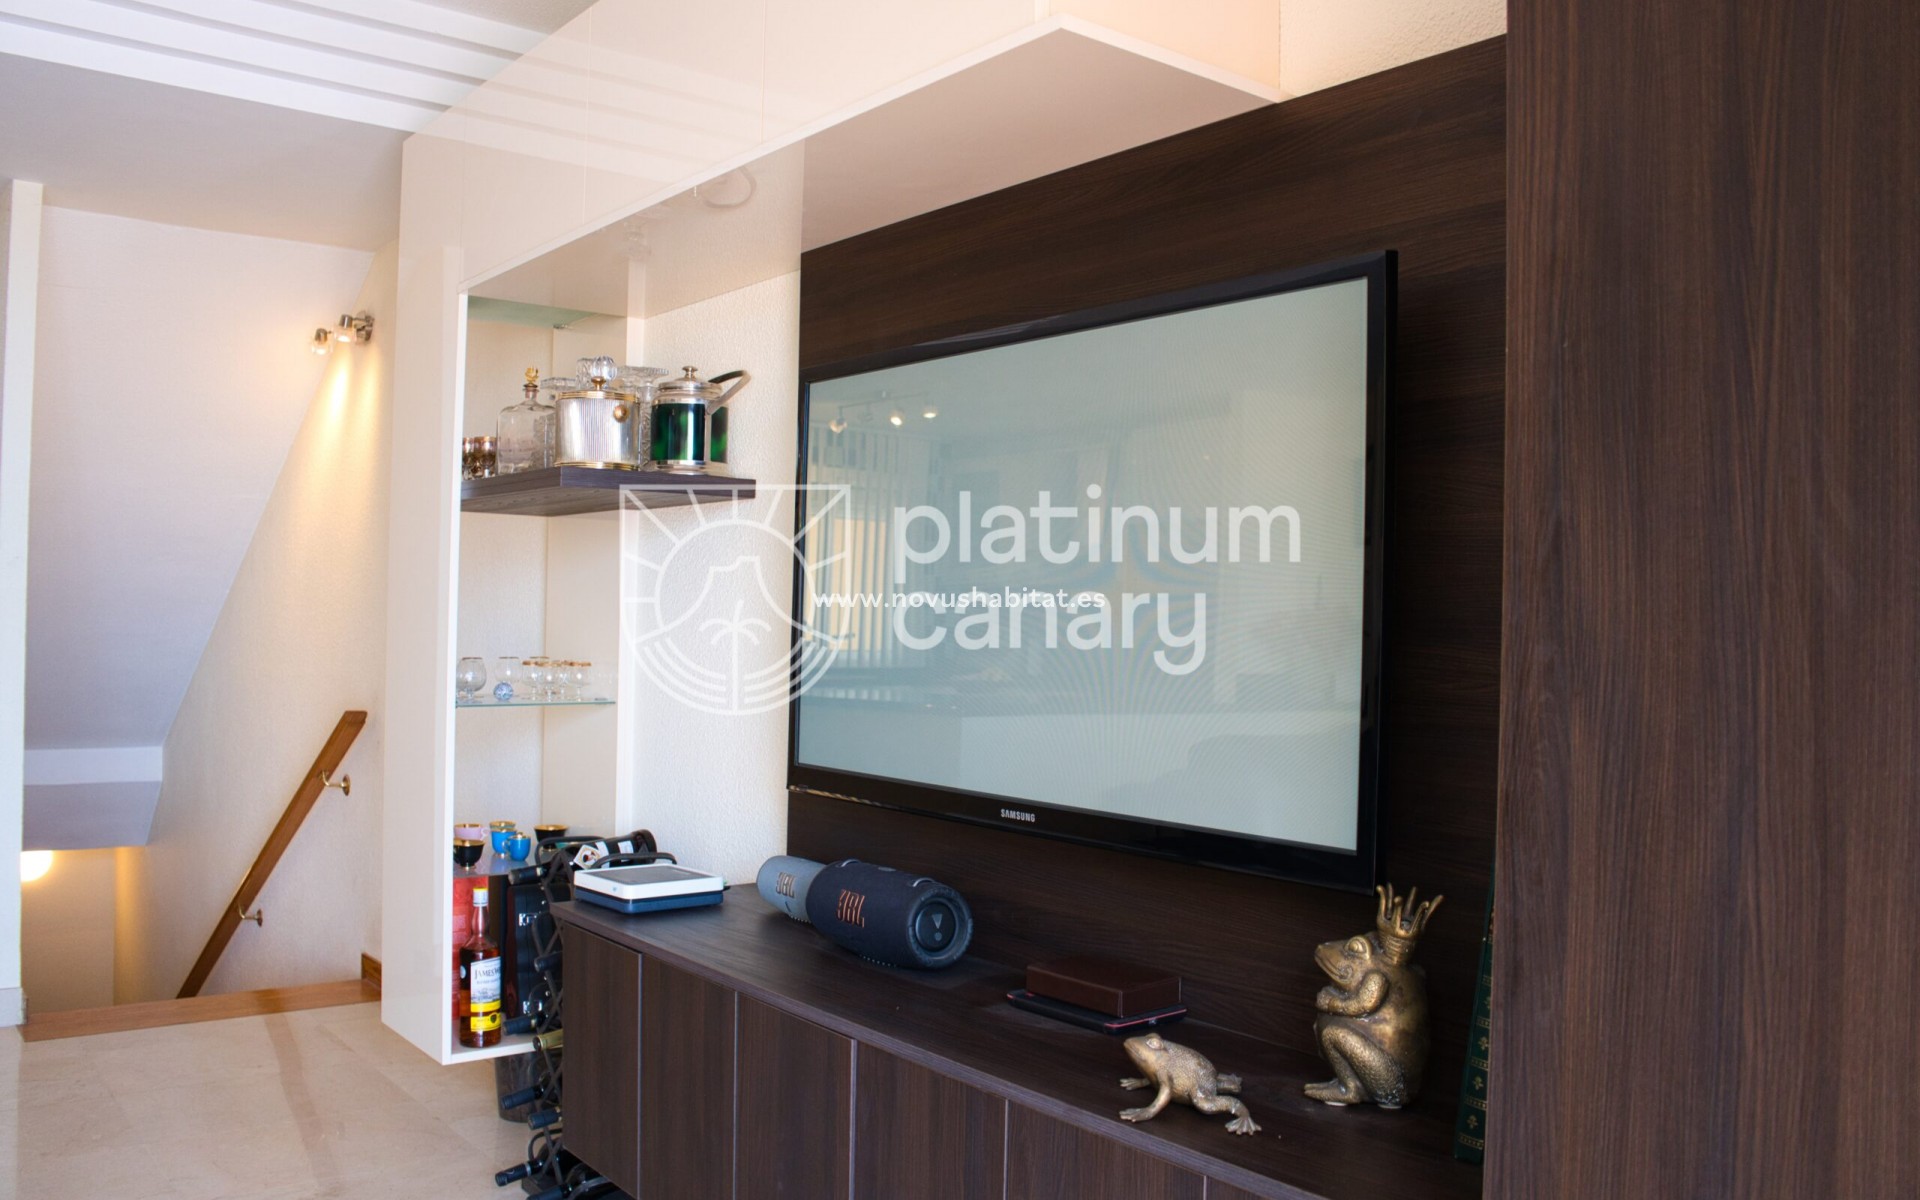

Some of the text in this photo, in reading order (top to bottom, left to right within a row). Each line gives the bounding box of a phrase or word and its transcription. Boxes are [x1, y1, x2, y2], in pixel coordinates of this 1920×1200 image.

[1000, 808, 1036, 823] SAMSUNG
[775, 872, 795, 898] JBL
[837, 889, 865, 928] JBL
